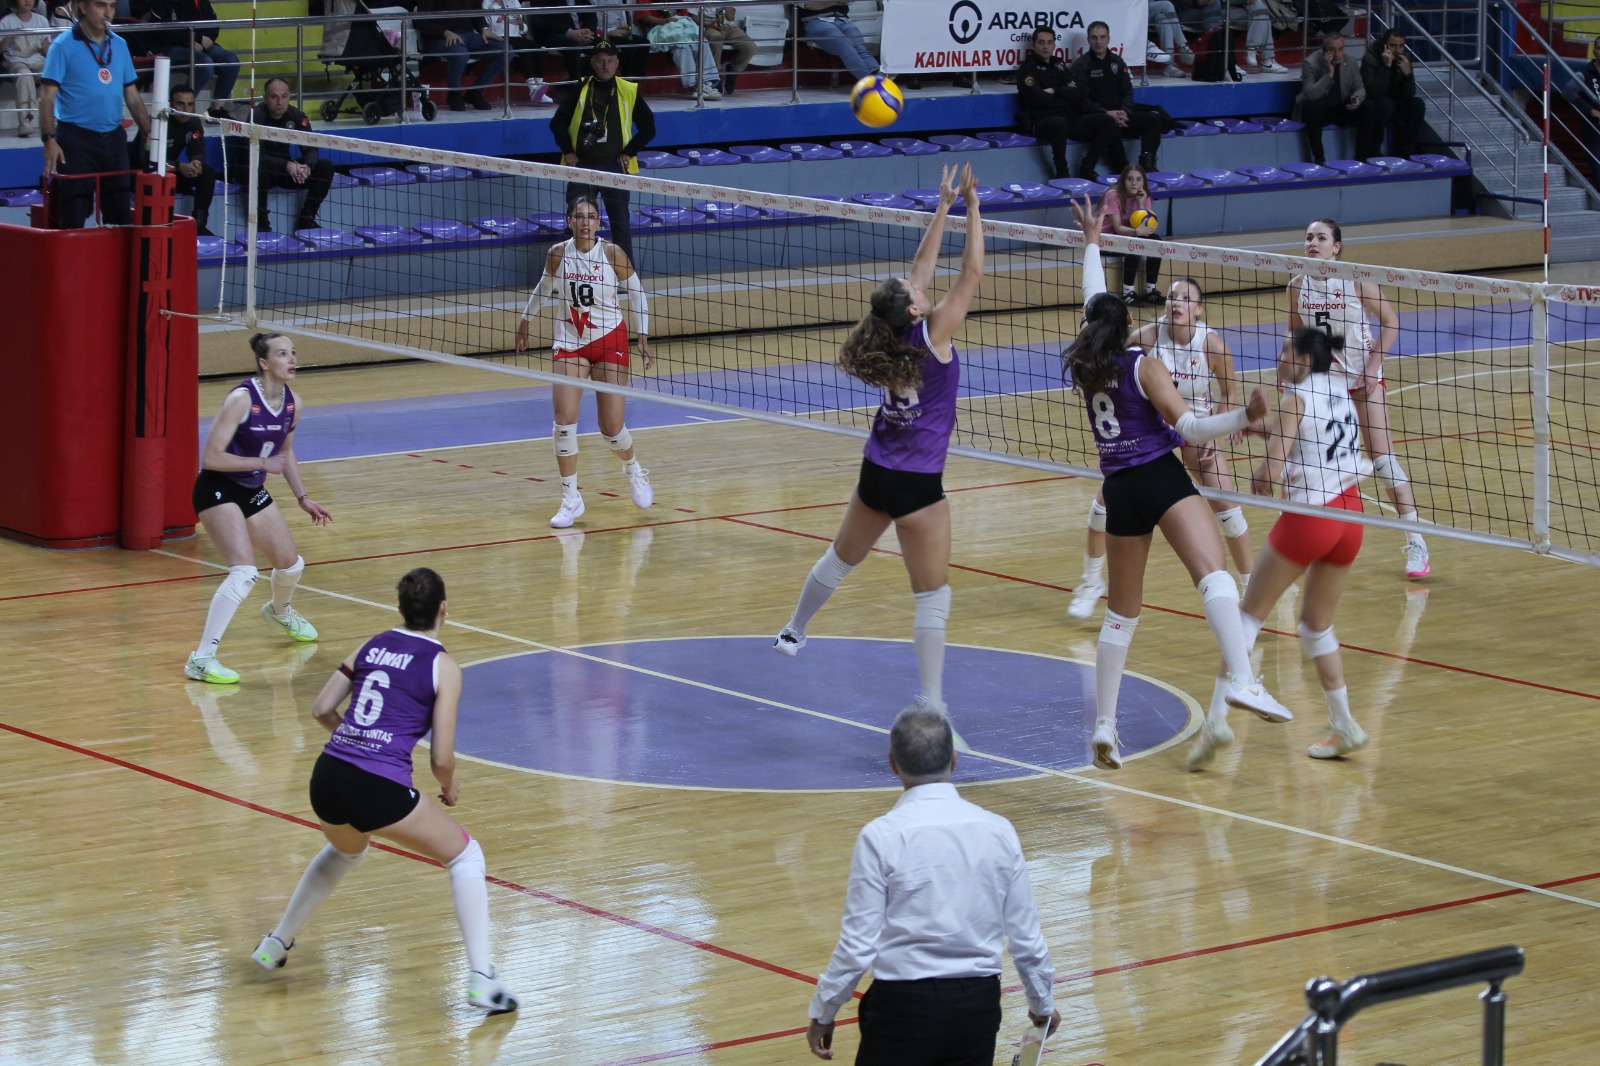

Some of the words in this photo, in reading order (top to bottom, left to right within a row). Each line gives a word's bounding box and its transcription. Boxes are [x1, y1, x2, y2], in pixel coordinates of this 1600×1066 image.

[988, 11, 1085, 30] ARABICA
[1010, 33, 1033, 42] Coffe
[915, 49, 992, 68] KADINLAR
[996, 48, 1073, 66] VOLOL
[570, 282, 595, 308] 18
[1302, 301, 1346, 310] kuzeyboru
[1315, 312, 1333, 337] 5
[1092, 392, 1121, 440] 8
[365, 648, 414, 670] SİMAY
[354, 670, 390, 726] 6
